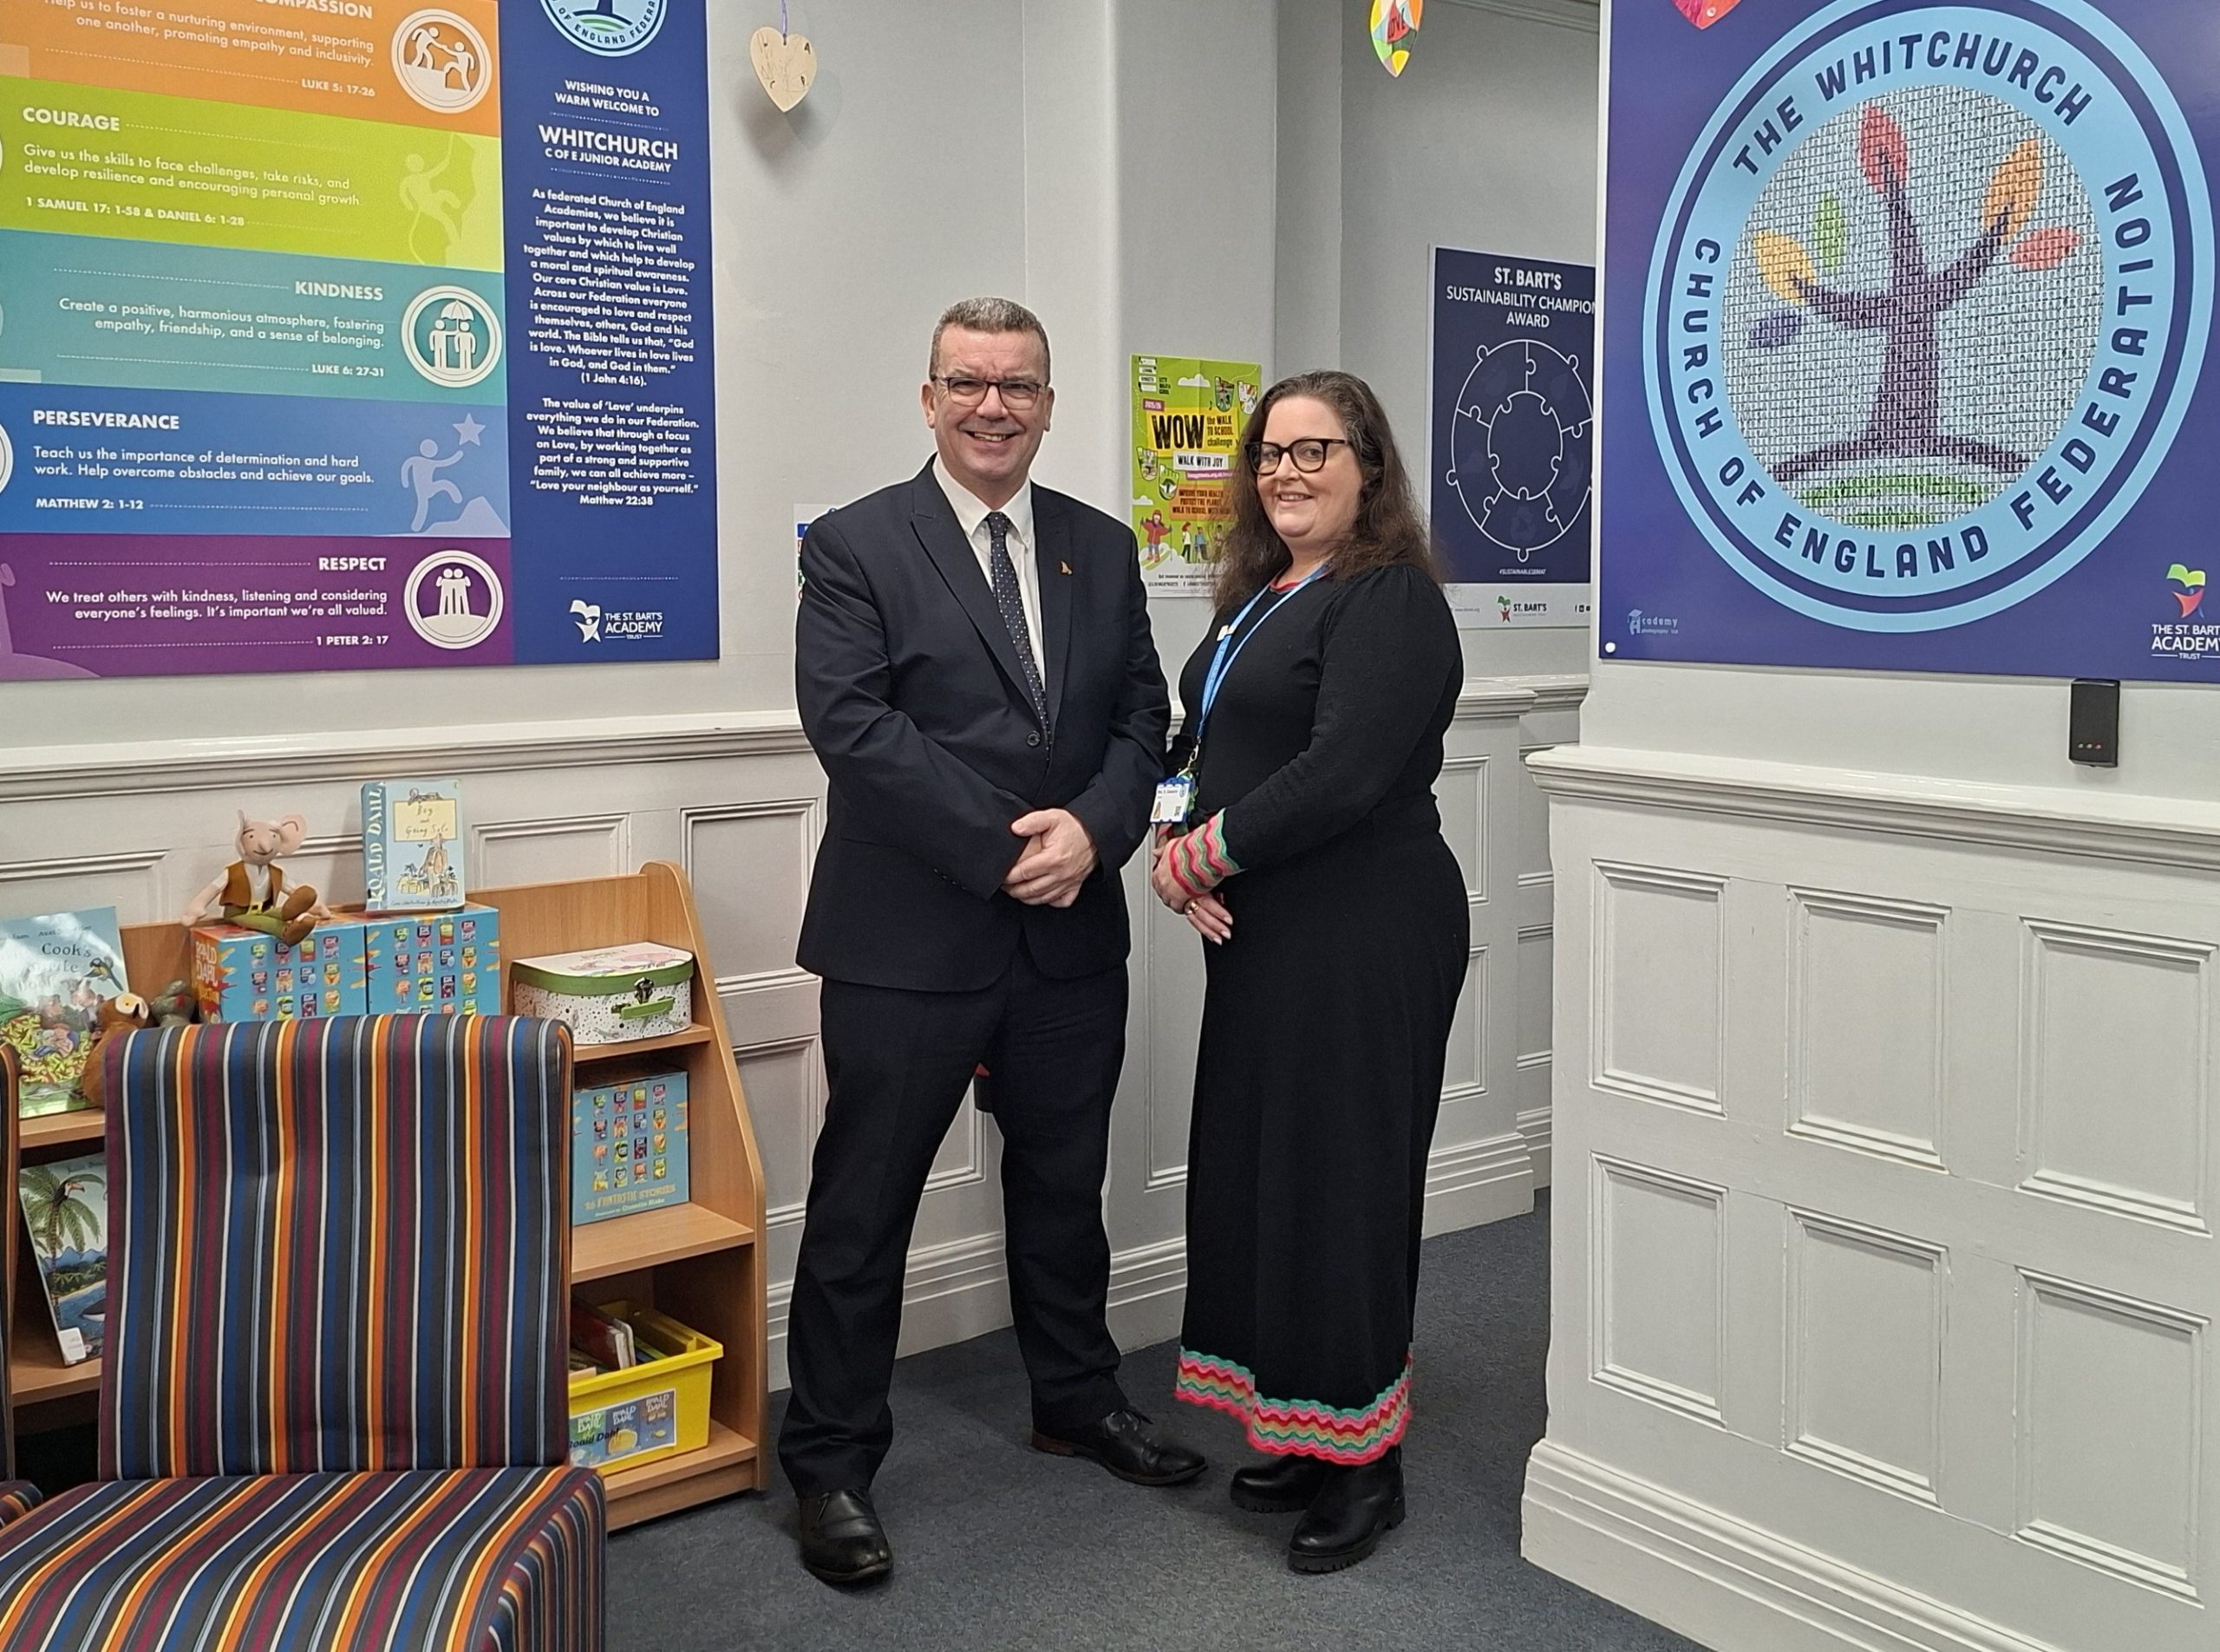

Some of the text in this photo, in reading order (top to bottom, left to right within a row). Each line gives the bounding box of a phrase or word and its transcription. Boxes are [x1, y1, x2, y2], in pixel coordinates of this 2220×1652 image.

[256, 0, 373, 19] MPASSION
[574, 23, 625, 44] ENGLAND
[630, 0, 656, 38] FEDERA
[301, 78, 375, 97] LUKE 5: 17-26
[565, 80, 650, 101] WISHING YOU A
[554, 92, 659, 117] WARM WELCOME TO
[1733, 30, 2093, 175] THE WHITCHURCH
[23, 107, 120, 130] COURAGE
[539, 125, 678, 160] WHITCHURCH
[23, 143, 349, 189] Give us the skills to face challenges, take risks, and
[545, 147, 671, 173] C OF E JUNIOR ACADEMY
[24, 160, 359, 206] develop resilience and encouraging personal growth
[26, 197, 245, 225] 1 SAMUEL 17: 1-58 & DANIEL 6: 1-28
[532, 187, 684, 214] As federated Church of England
[544, 203, 602, 220] Academies,
[620, 211, 656, 225] believe
[657, 216, 665, 225] it
[666, 217, 675, 227] is
[535, 216, 682, 241] important to develop Christian
[543, 231, 676, 254] values by which to live well
[1494, 266, 1562, 291] ST. BART'S
[295, 280, 383, 301] KINDNESS
[1446, 285, 1537, 309] SUSTAINABILITY
[59, 297, 104, 312] Create
[121, 304, 174, 319] positive,
[179, 305, 251, 323] harmonious
[255, 313, 330, 330] atmosphere,
[333, 316, 383, 335] fostering
[1506, 311, 1550, 328] AWARD
[311, 364, 383, 376] LUKE 6: 27-31
[581, 371, 647, 387] (1 John 4:16).
[1682, 173, 2153, 578] CHURCH OF ENGLAND FEDERATION
[33, 410, 179, 429] PERSEVERANCE
[1214, 426, 1234, 435] SCHOOL
[1216, 415, 1232, 425] WALK
[1152, 415, 1205, 449] WOW
[1207, 438, 1233, 448] challenge
[36, 446, 74, 458] Teach
[96, 447, 117, 459] the
[121, 448, 194, 463] importance
[199, 450, 212, 462] of
[215, 451, 300, 465] determination
[304, 454, 327, 466] and
[330, 454, 358, 467] hard
[1178, 454, 1224, 468] WALK WITH JOY
[34, 462, 73, 475] work.
[78, 463, 108, 479] Help
[113, 468, 175, 477] overcome
[179, 466, 236, 479] obstacles
[239, 467, 264, 480] and
[267, 468, 312, 481] achieve
[339, 470, 374, 485] goals.
[36, 498, 143, 509] MATTHEW 2: 1-12
[579, 494, 653, 505] Matthew 22:38
[318, 557, 386, 570] RESPECT
[605, 622, 663, 633] ACADEMY
[2151, 624, 2220, 636] THE ST. BART
[326, 636, 359, 644] PETER
[361, 636, 373, 644] 2:
[376, 635, 388, 643] 17
[366, 781, 386, 836] DAHL
